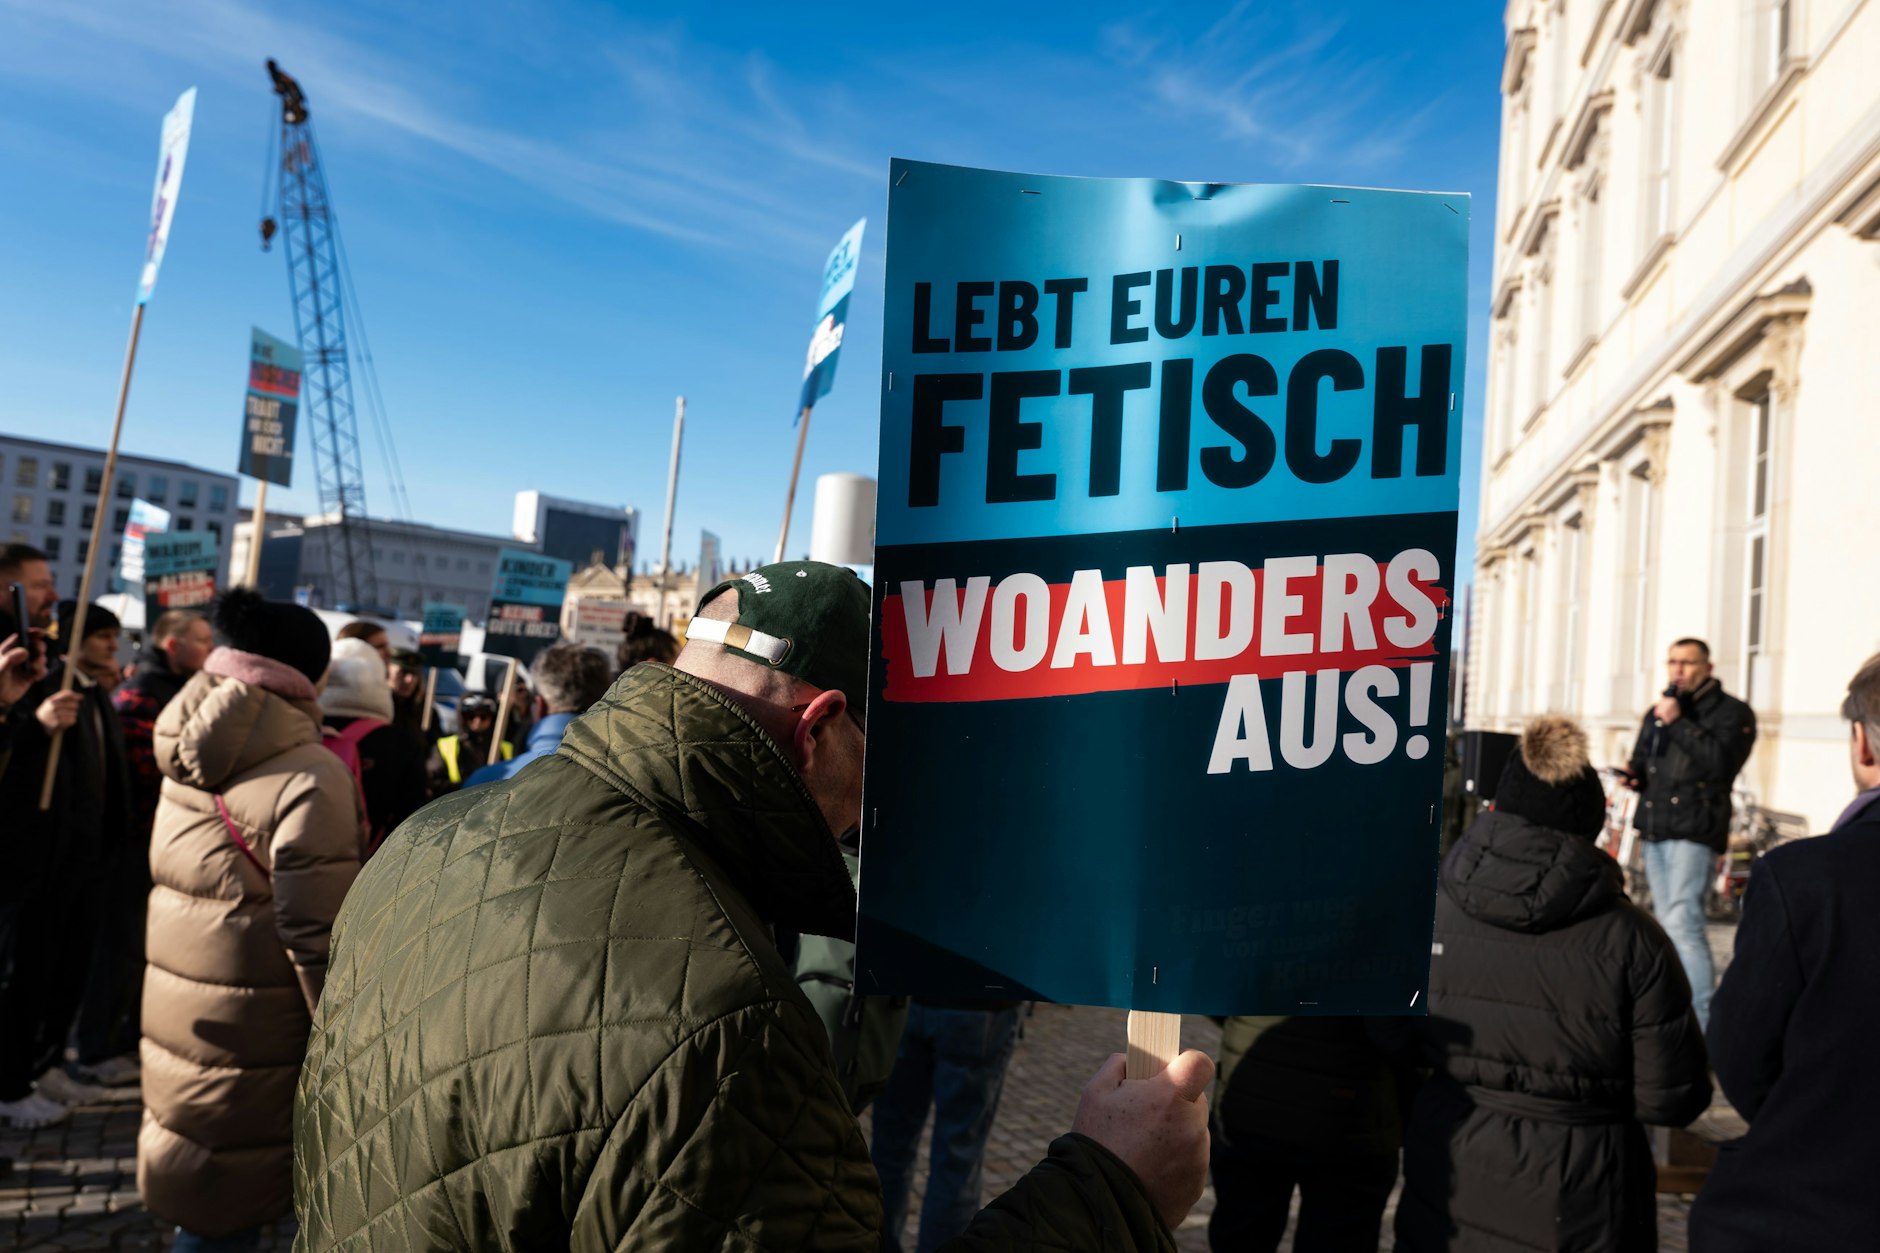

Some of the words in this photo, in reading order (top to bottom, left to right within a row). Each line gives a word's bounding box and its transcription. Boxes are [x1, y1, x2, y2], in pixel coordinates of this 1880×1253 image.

[911, 276, 1088, 354] LEBT
[1109, 259, 1340, 346] EUREN
[907, 343, 1453, 509] FETISCH
[899, 548, 1441, 679] WOANDERS
[1206, 661, 1434, 775] AUS!
